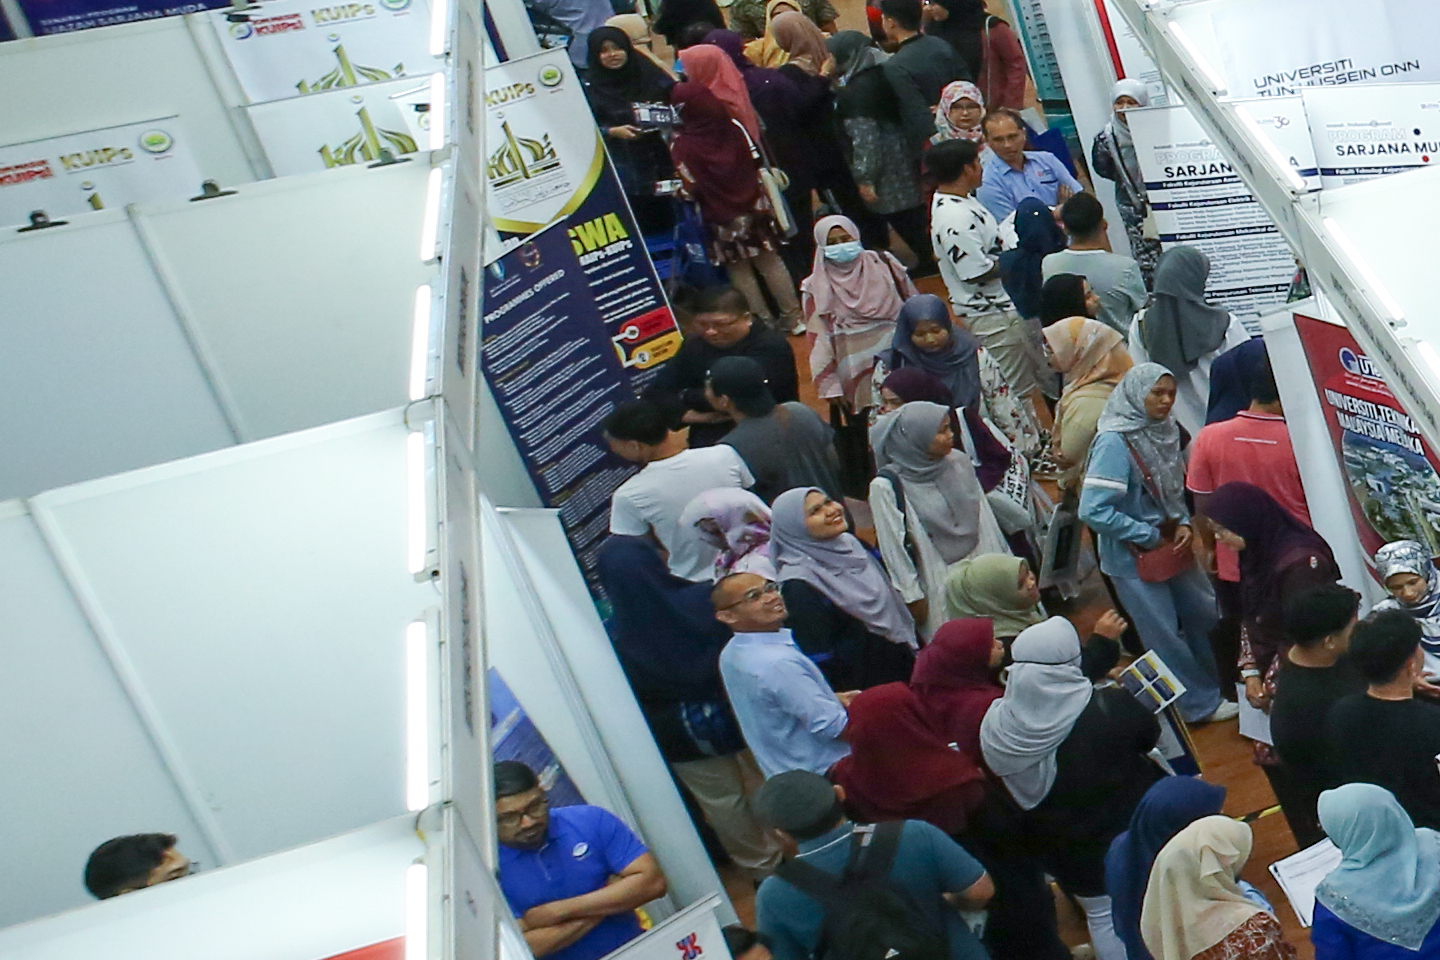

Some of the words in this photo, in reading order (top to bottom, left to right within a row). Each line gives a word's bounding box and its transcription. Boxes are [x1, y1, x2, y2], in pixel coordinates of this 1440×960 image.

[1253, 57, 1354, 89] UNIVERSITI
[1379, 58, 1421, 77] ONN
[1335, 142, 1411, 157] SARJANA
[484, 289, 535, 325] PROGRAMMES
[533, 268, 567, 295] OFFERED
